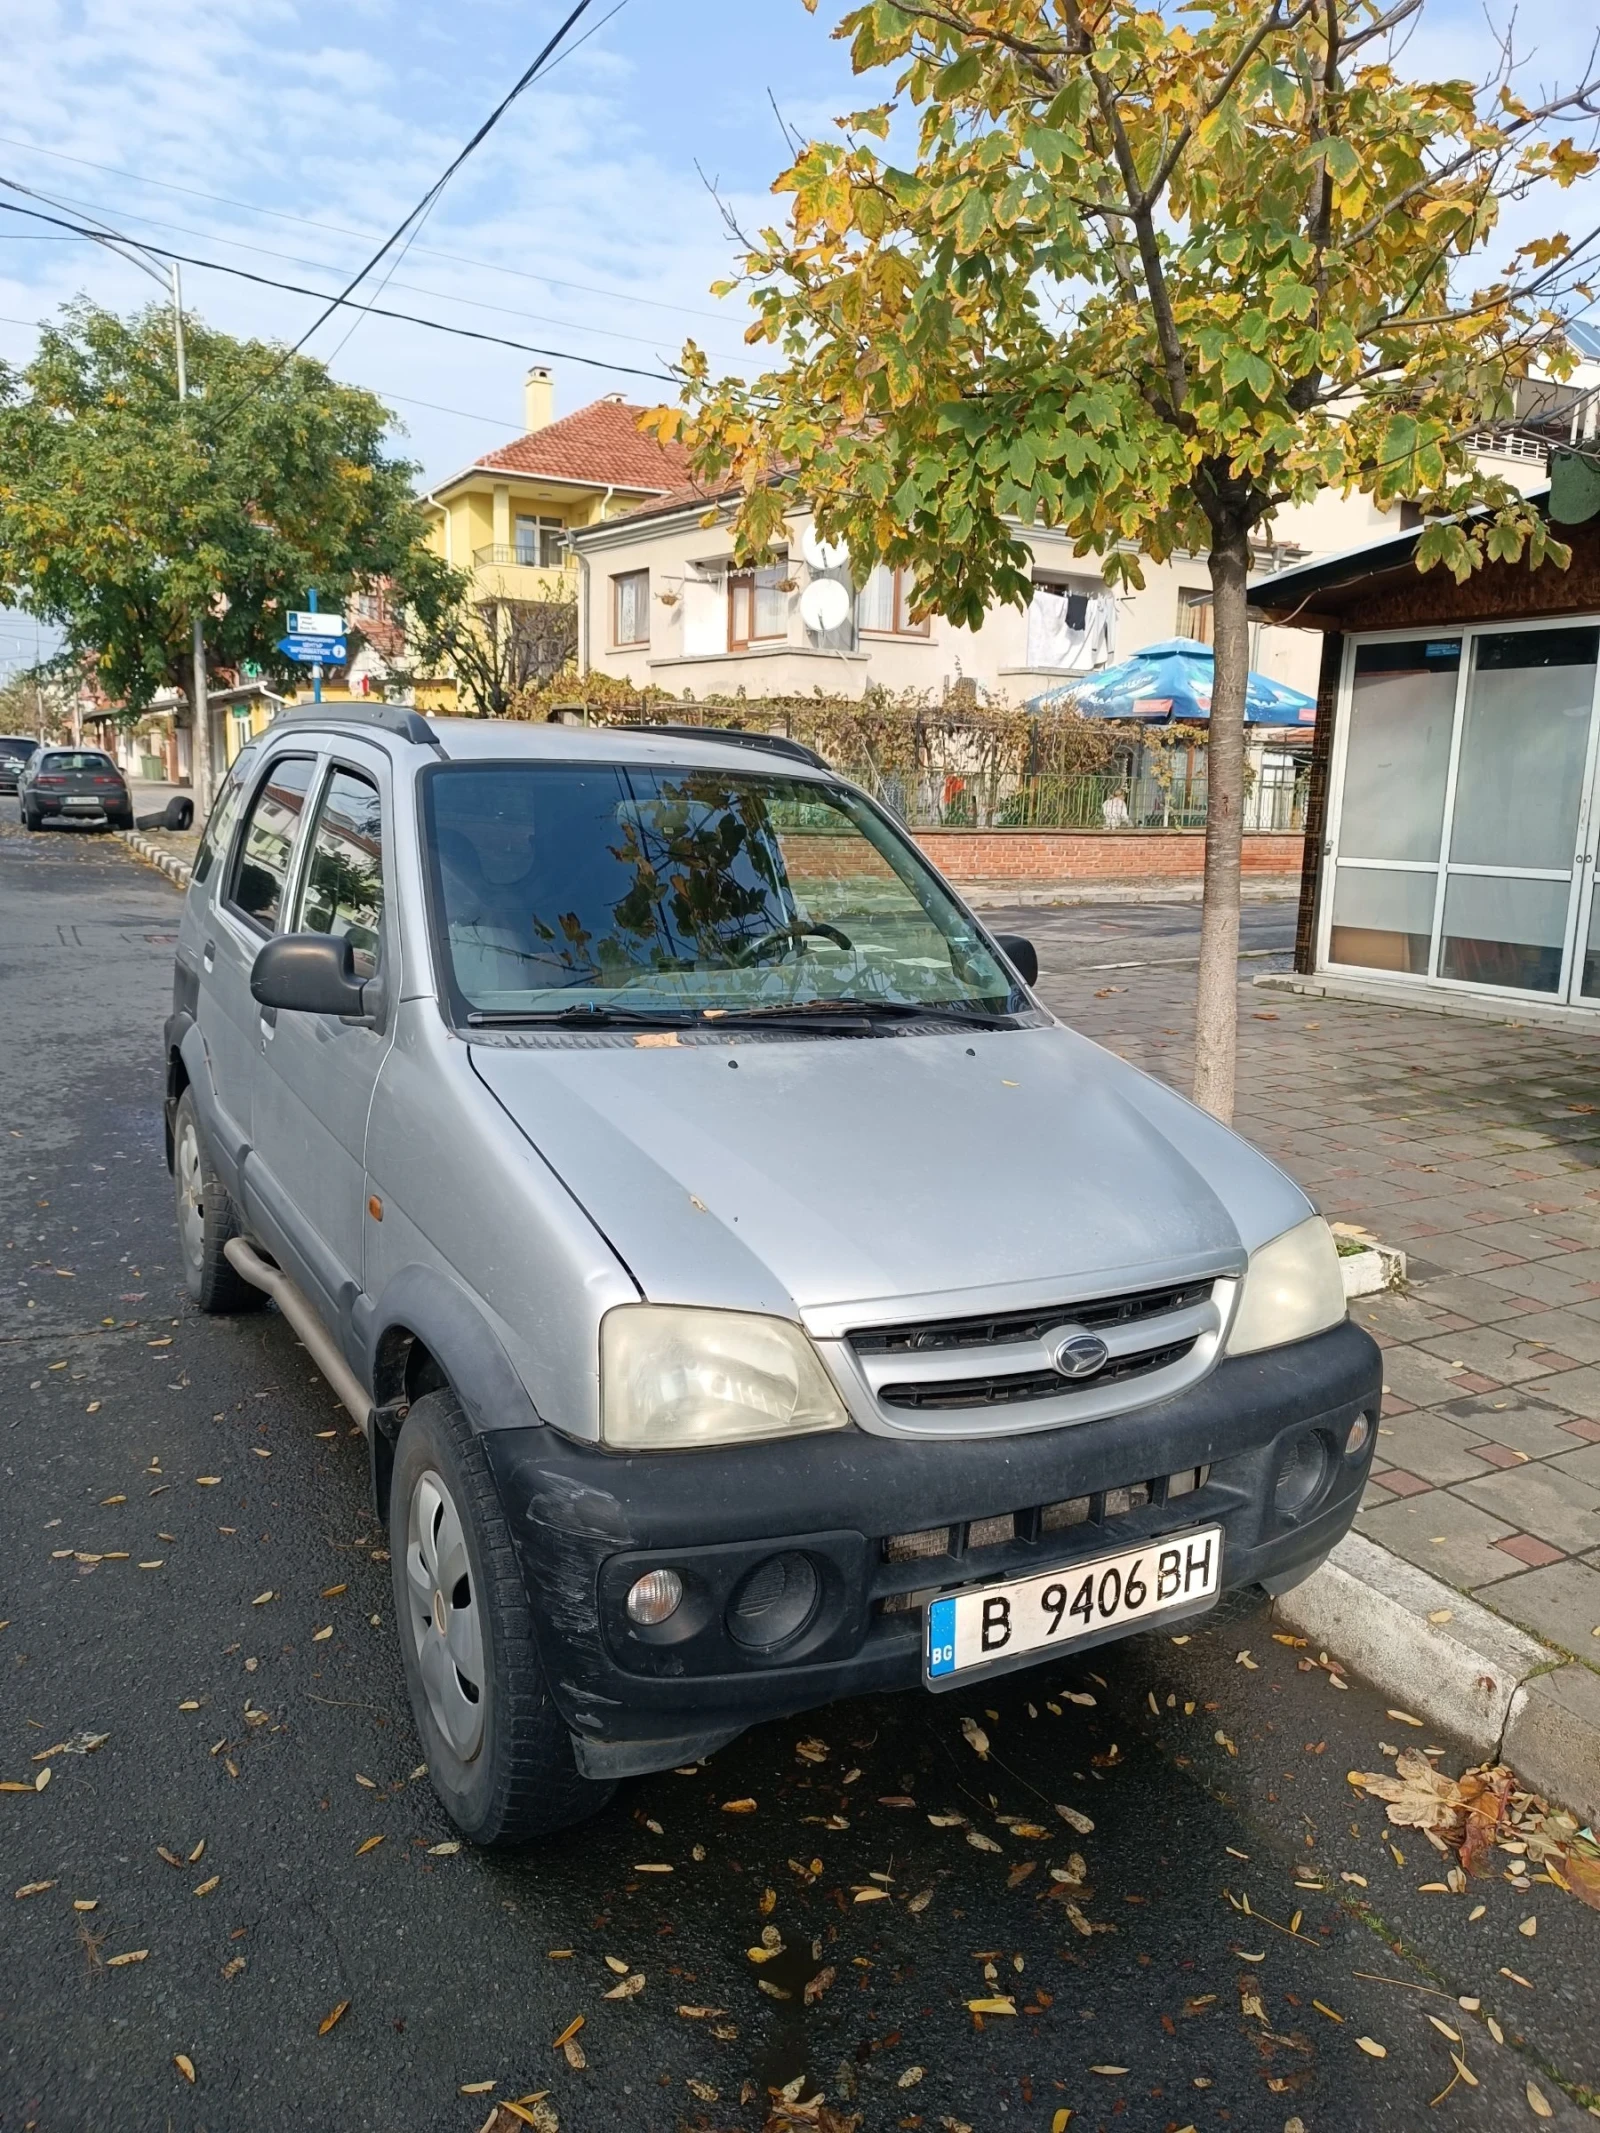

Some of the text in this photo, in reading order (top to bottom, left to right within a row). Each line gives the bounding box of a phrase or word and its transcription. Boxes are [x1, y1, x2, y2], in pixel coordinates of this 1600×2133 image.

[981, 1539, 1212, 1653] B 9406 BH
[932, 1645, 953, 1665] BG
